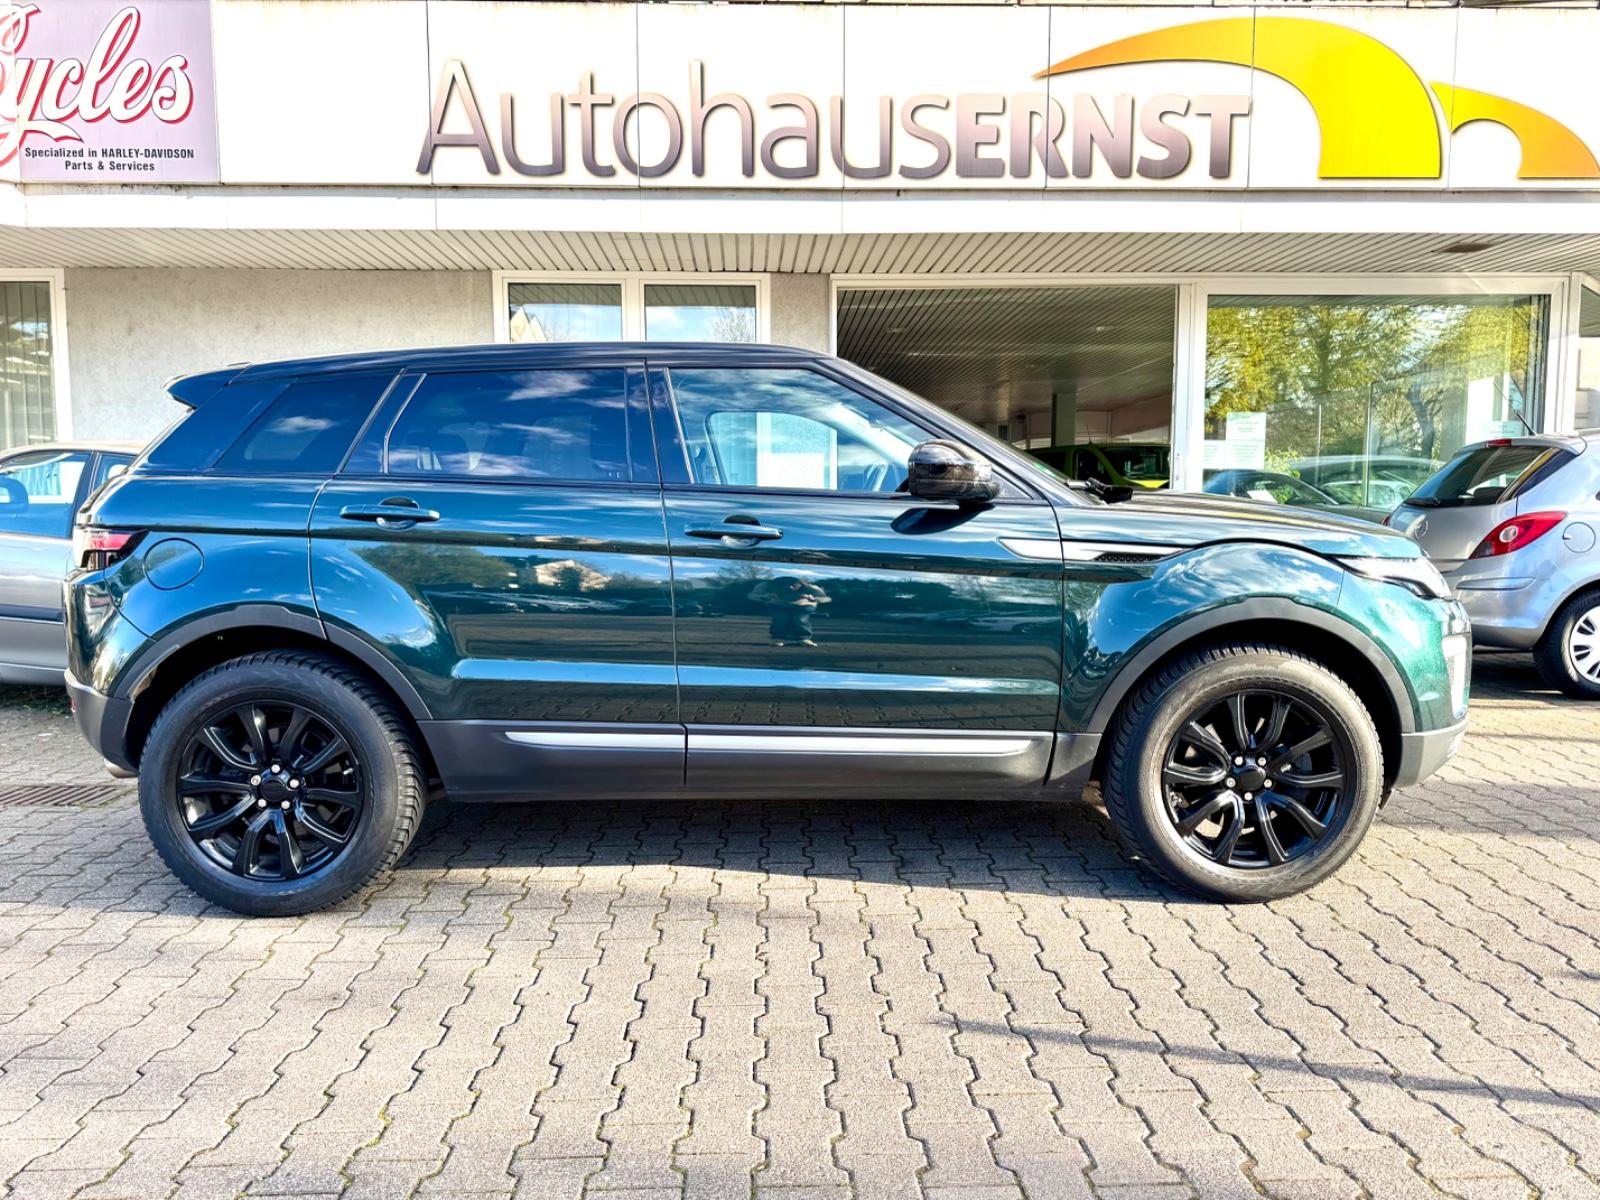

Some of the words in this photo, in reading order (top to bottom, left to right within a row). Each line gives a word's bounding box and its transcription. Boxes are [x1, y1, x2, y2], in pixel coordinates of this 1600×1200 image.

[415, 58, 1251, 178] AutohausERNST
[25, 147, 84, 159] Specialized
[88, 149, 98, 158] in
[101, 148, 194, 159] HARLEY-DAVIDSON
[65, 160, 93, 170] Parts
[98, 161, 105, 171] &
[109, 160, 155, 171] Services
